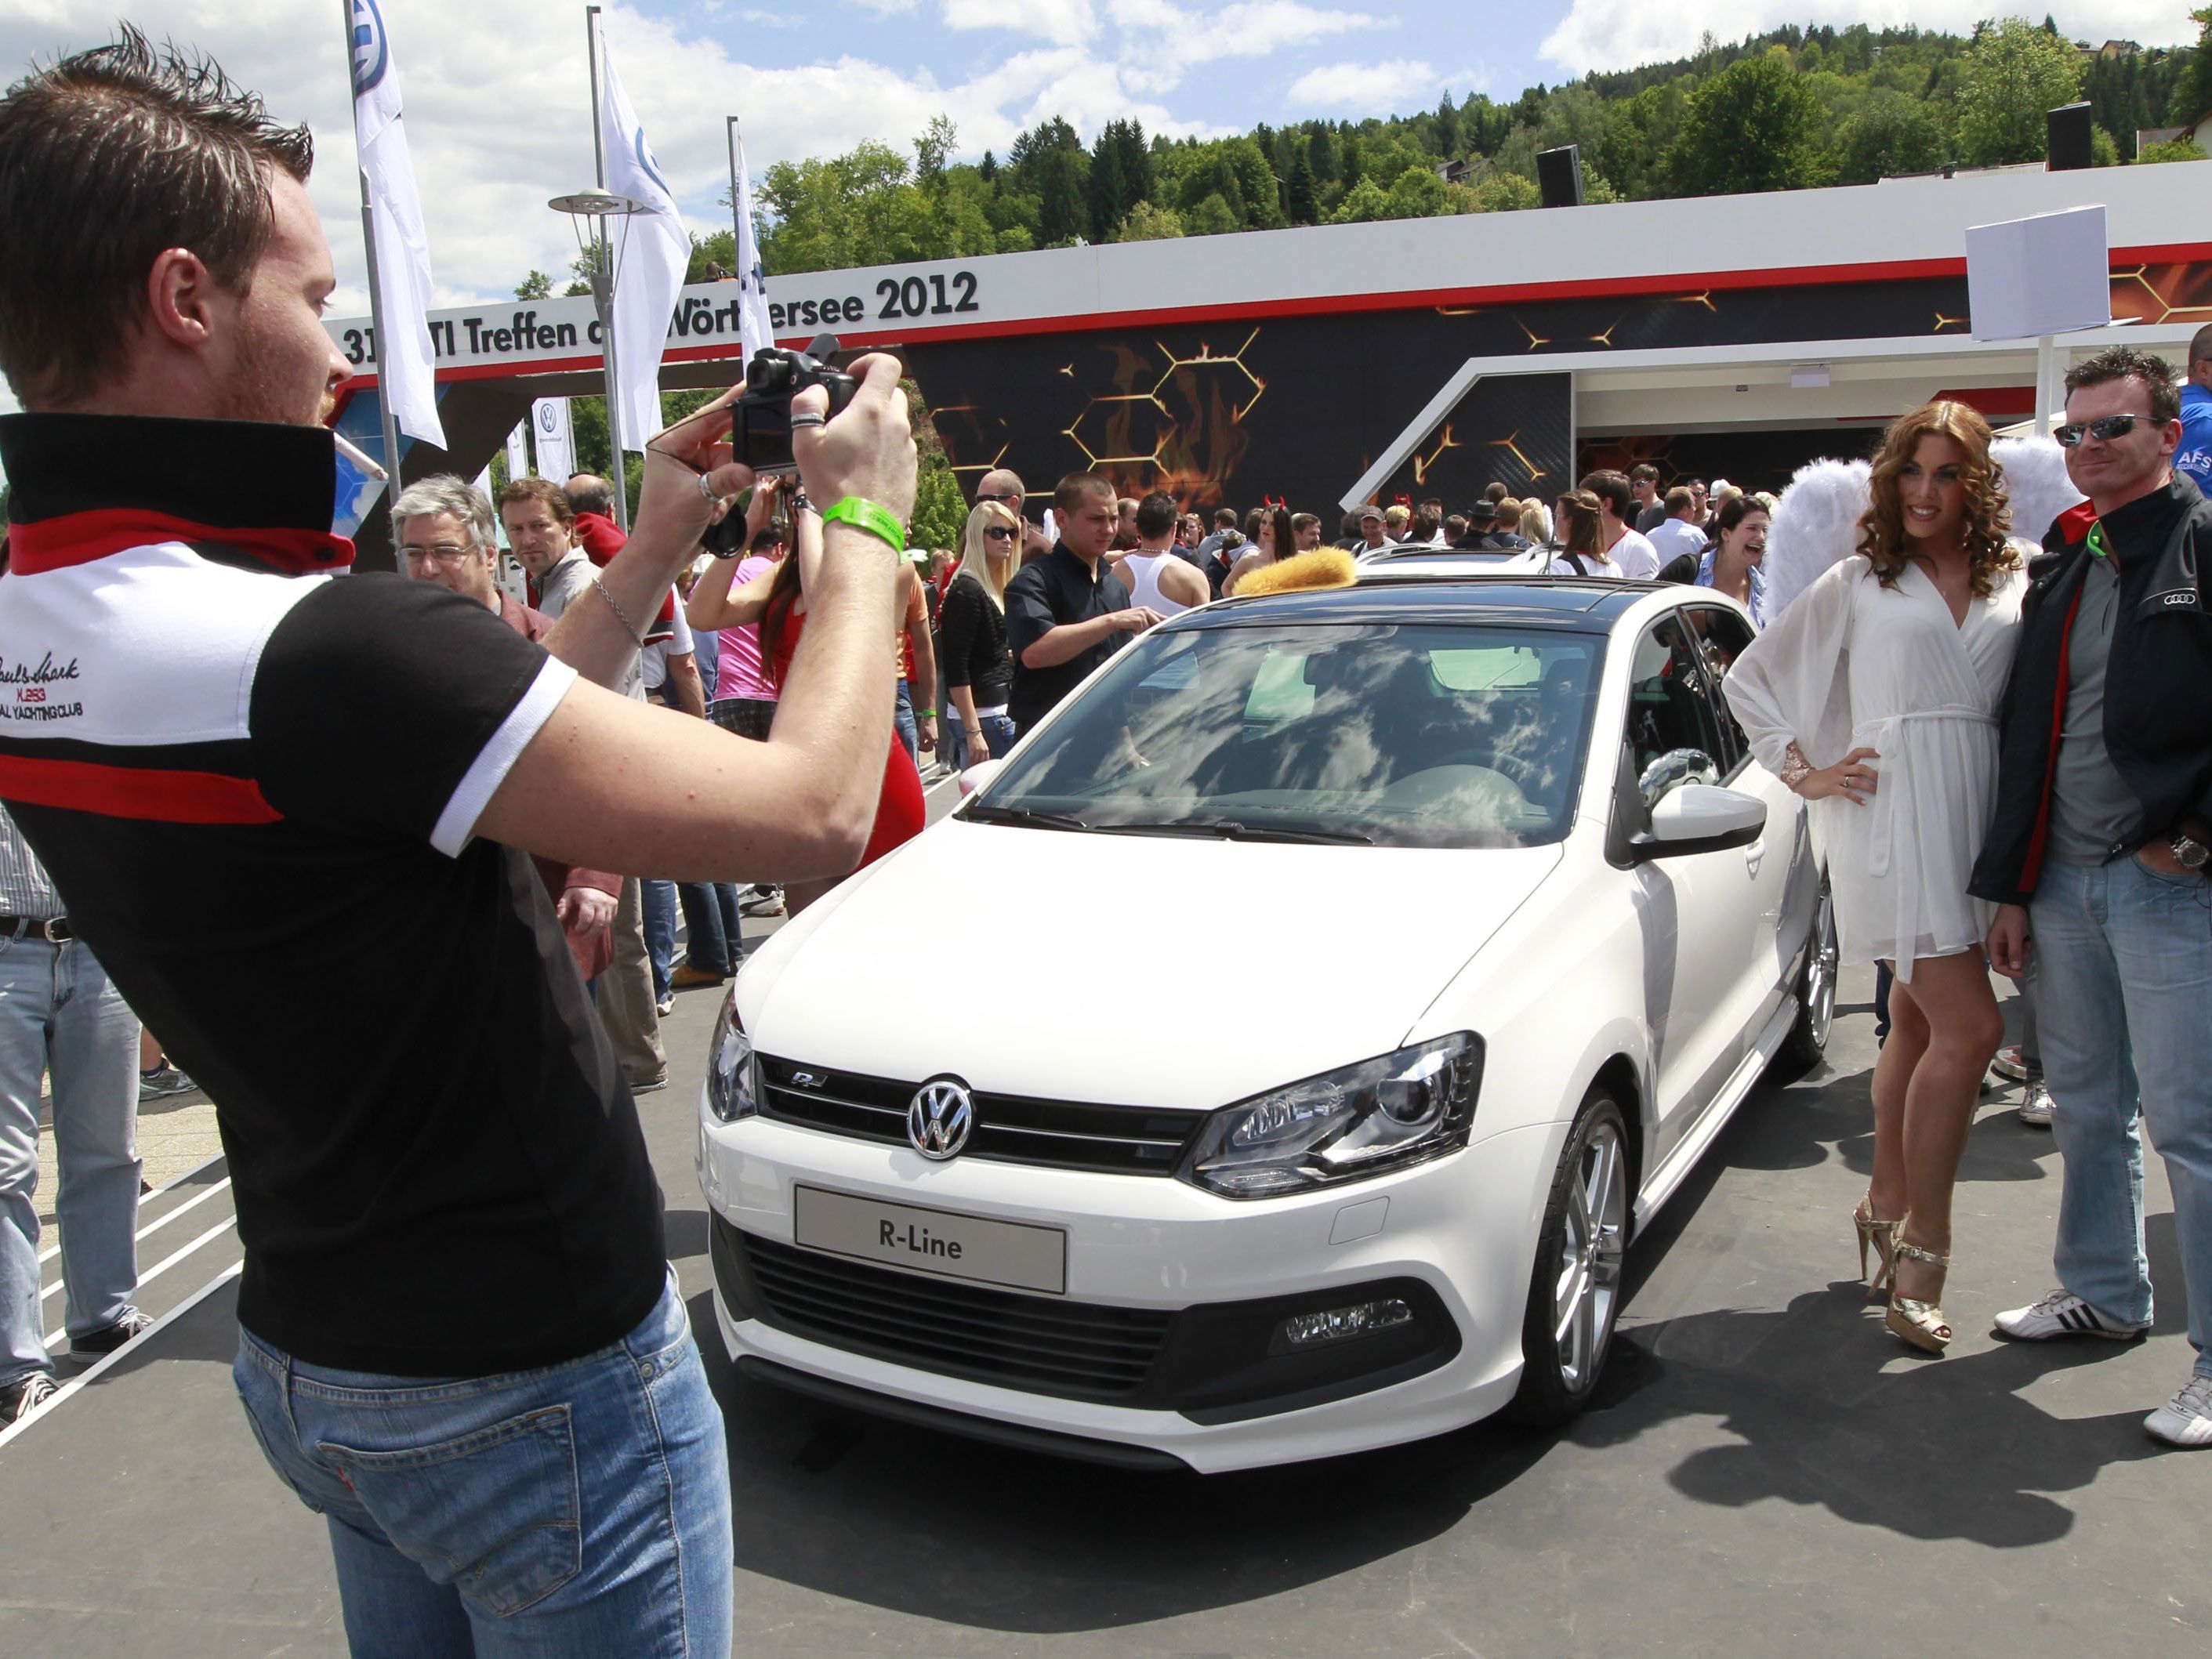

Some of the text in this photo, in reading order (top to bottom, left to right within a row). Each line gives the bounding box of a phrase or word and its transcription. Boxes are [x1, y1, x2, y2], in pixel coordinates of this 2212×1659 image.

[428, 321, 456, 357] TI
[462, 311, 578, 354] Treffen
[667, 296, 864, 338] Wörtersee
[876, 271, 979, 320] 2012
[2178, 451, 2212, 469] AFS
[13, 705, 58, 721] YACHTING
[57, 702, 83, 718] CLUB
[879, 1219, 963, 1260] R-Line
